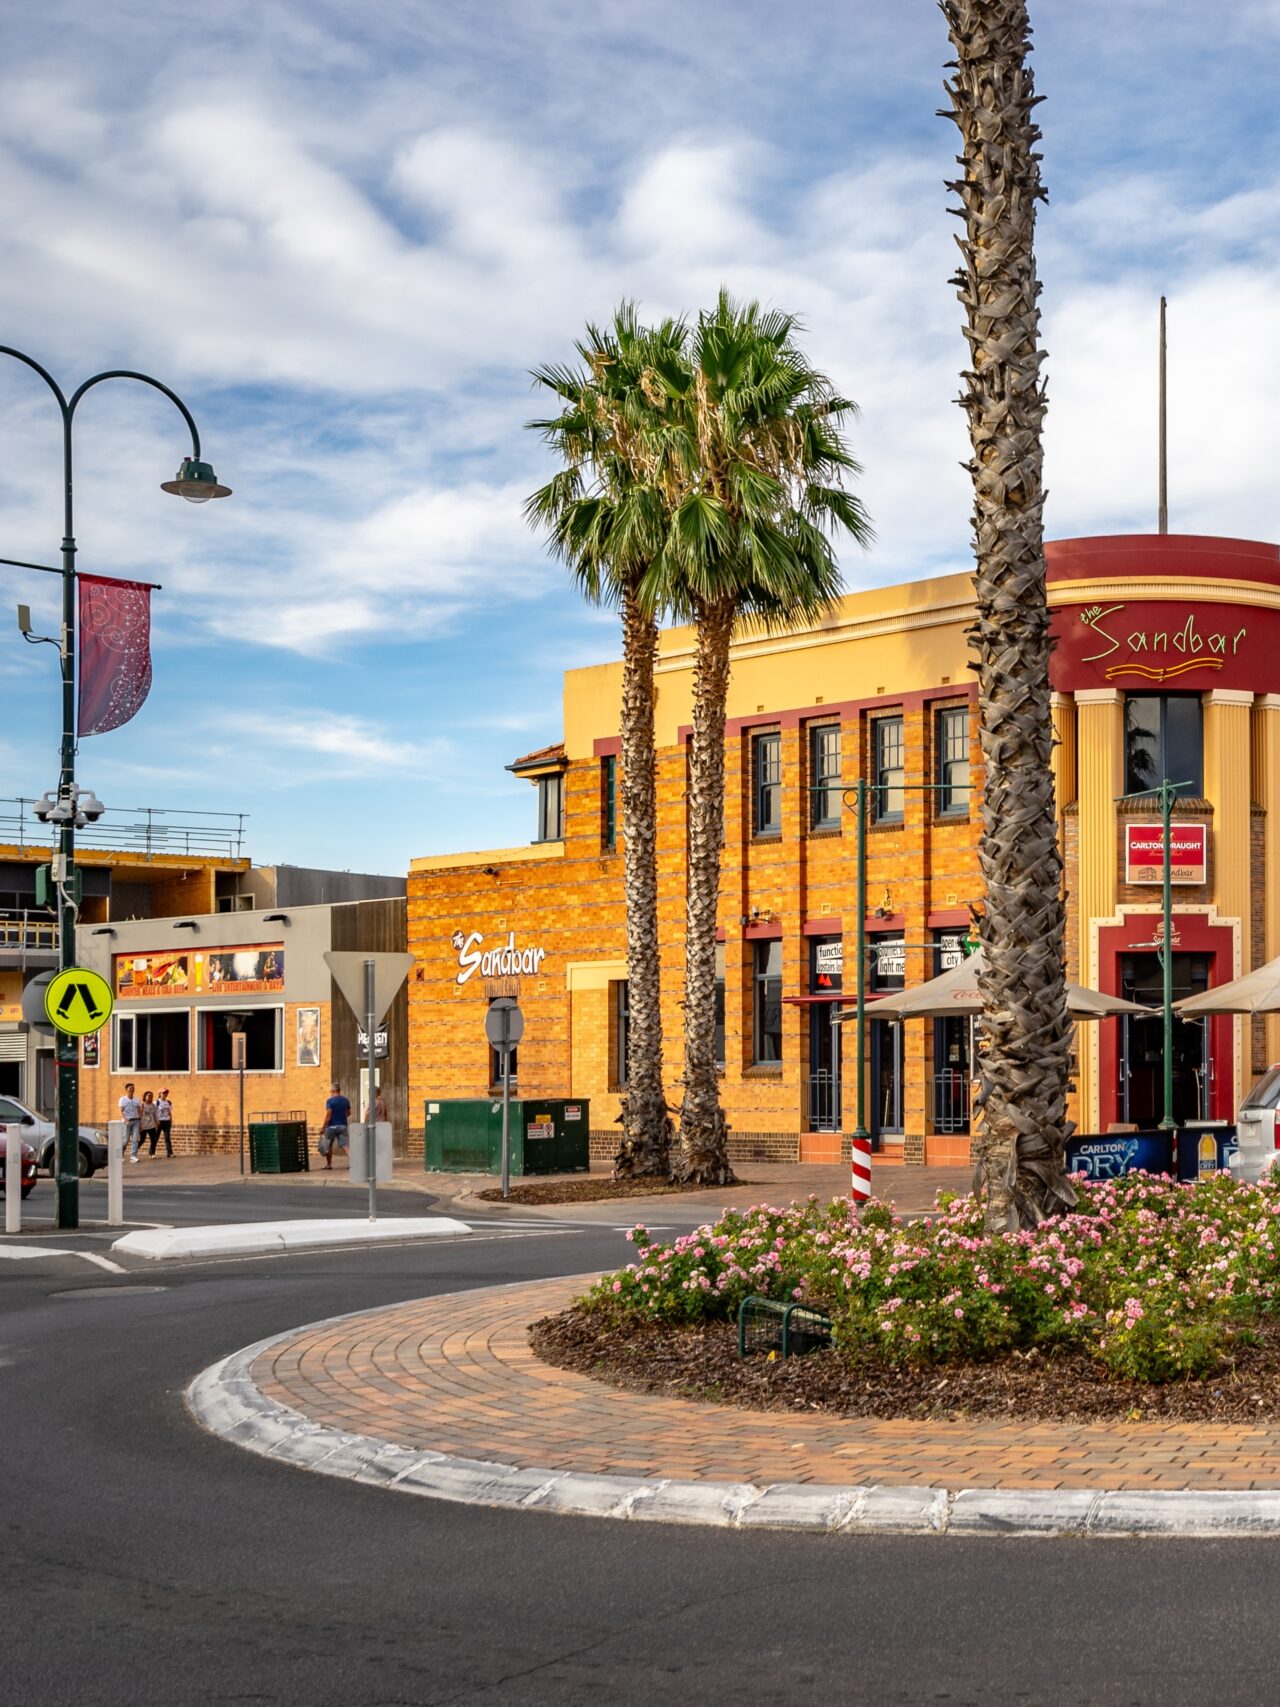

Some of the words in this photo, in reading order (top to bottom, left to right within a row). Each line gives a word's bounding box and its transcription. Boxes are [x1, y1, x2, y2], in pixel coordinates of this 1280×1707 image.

[1082, 605, 1246, 662] Sandbar
[1130, 842, 1164, 850] CARLTON
[1168, 842, 1202, 850] RAUGHT
[457, 931, 545, 984] Sandbar
[1080, 1144, 1126, 1155] CARLTON
[1071, 1152, 1136, 1180] DRY
